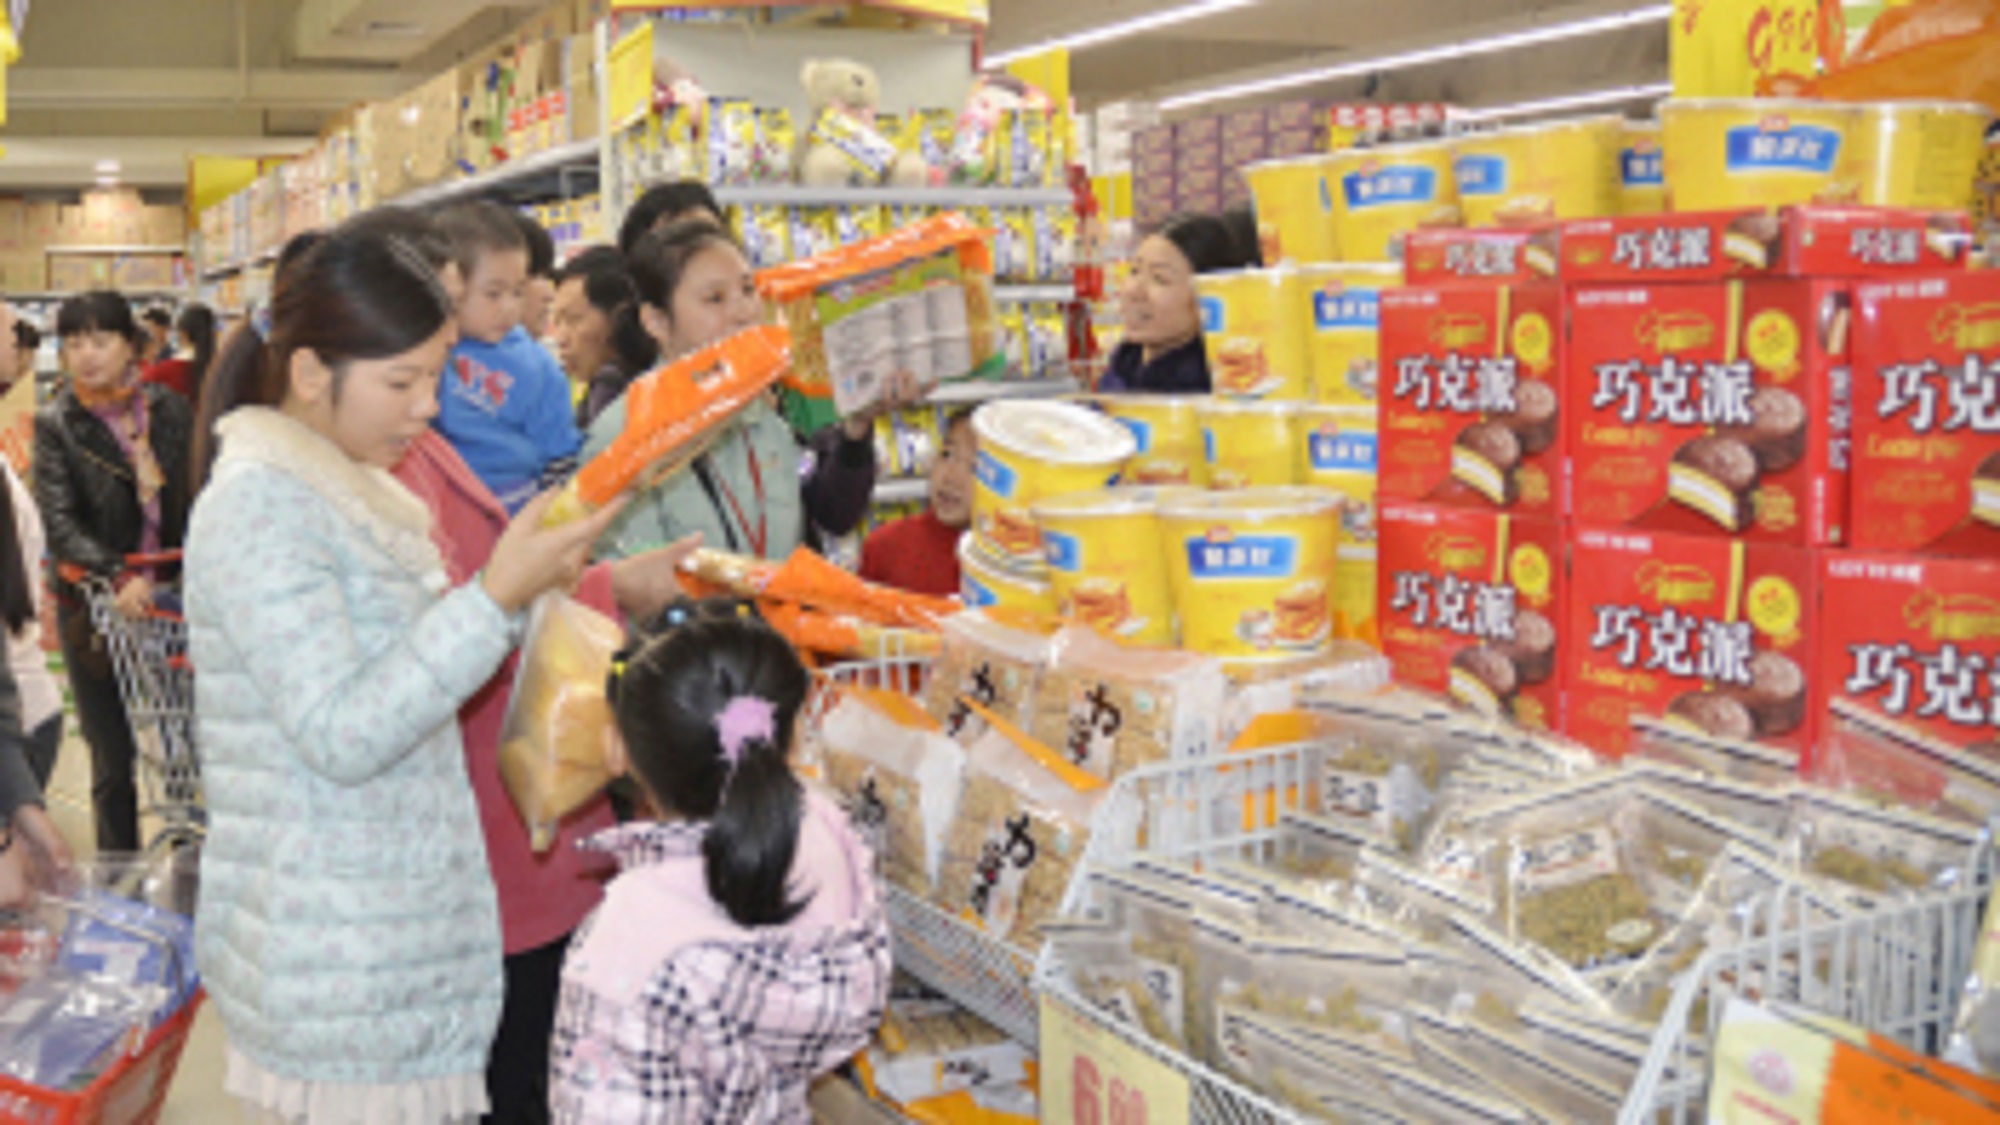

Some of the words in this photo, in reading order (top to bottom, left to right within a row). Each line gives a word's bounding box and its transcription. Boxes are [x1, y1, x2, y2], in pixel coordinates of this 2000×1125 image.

[1611, 227, 1710, 270] 巧克派
[1394, 350, 1518, 413] 巧克派
[1591, 356, 1754, 424] 巧克派
[1391, 570, 1516, 640] 巧克派
[1590, 604, 1753, 685] 巧克派
